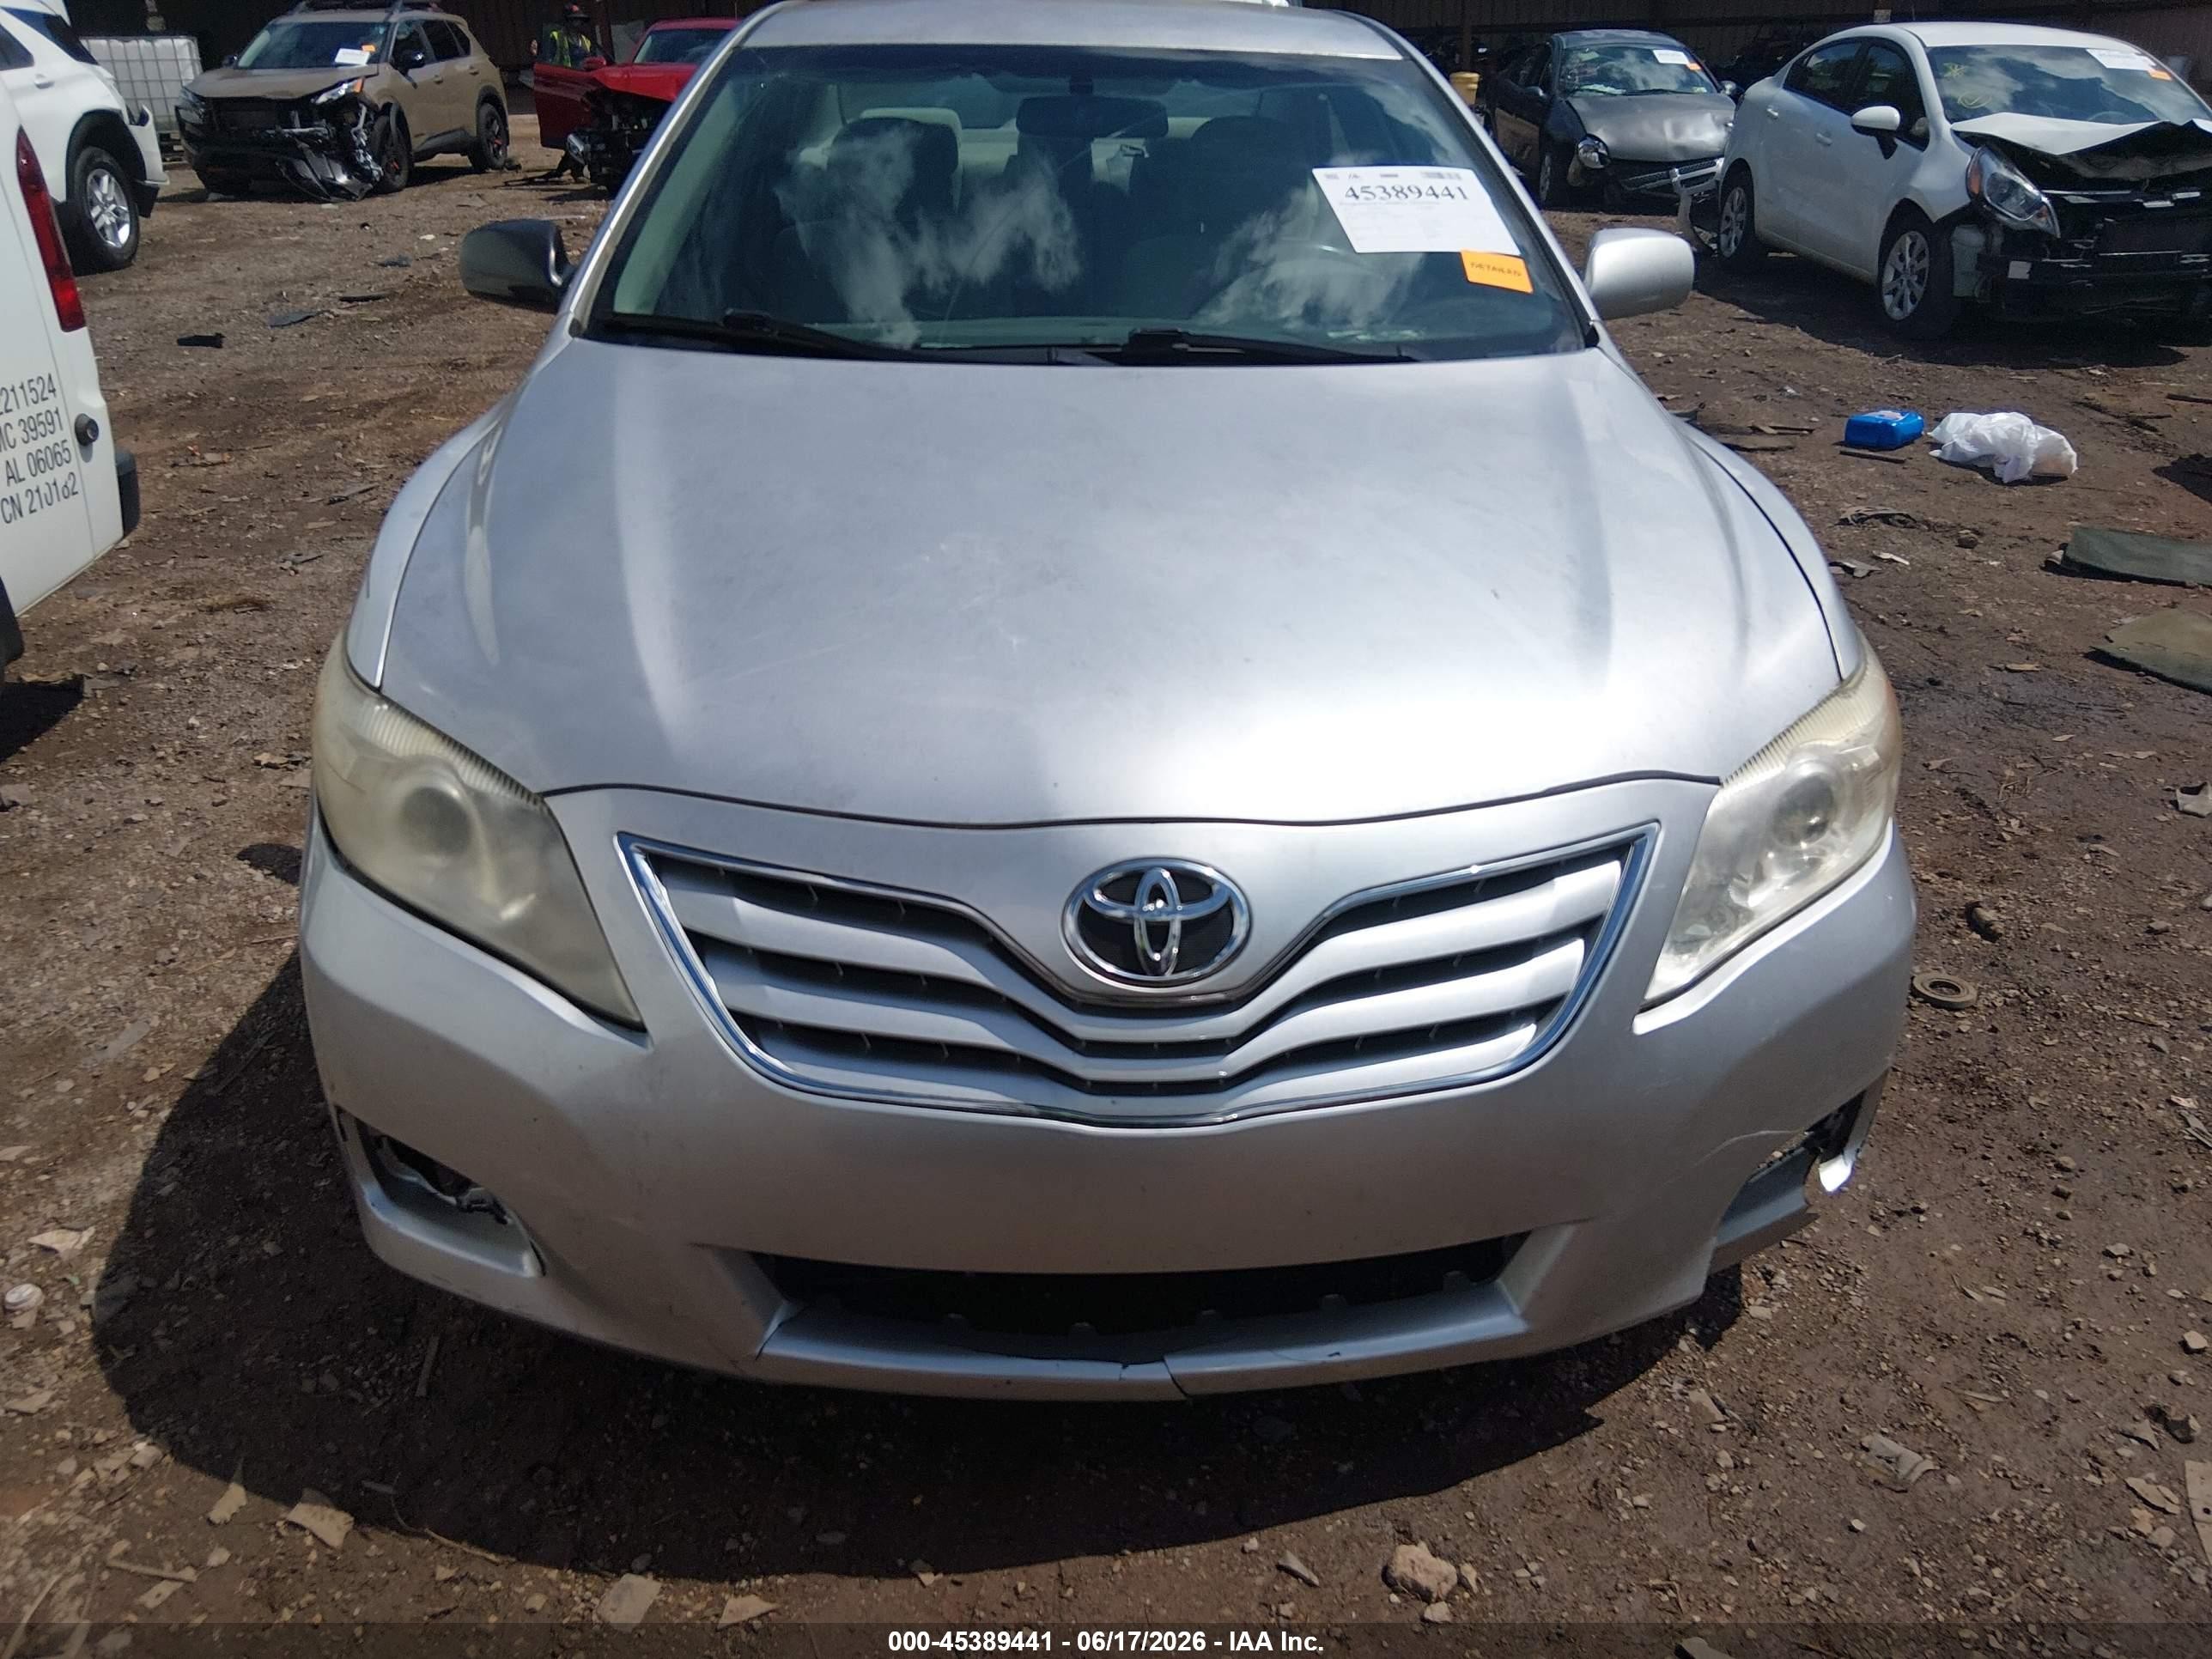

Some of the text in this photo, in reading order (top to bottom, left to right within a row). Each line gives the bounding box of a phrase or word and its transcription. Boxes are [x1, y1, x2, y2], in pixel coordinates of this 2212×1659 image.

[1345, 185, 1469, 201] 45389441
[0, 373, 57, 416] 211524
[18, 407, 64, 445] 39591
[5, 439, 72, 488] AL 06065
[0, 492, 24, 524] CN
